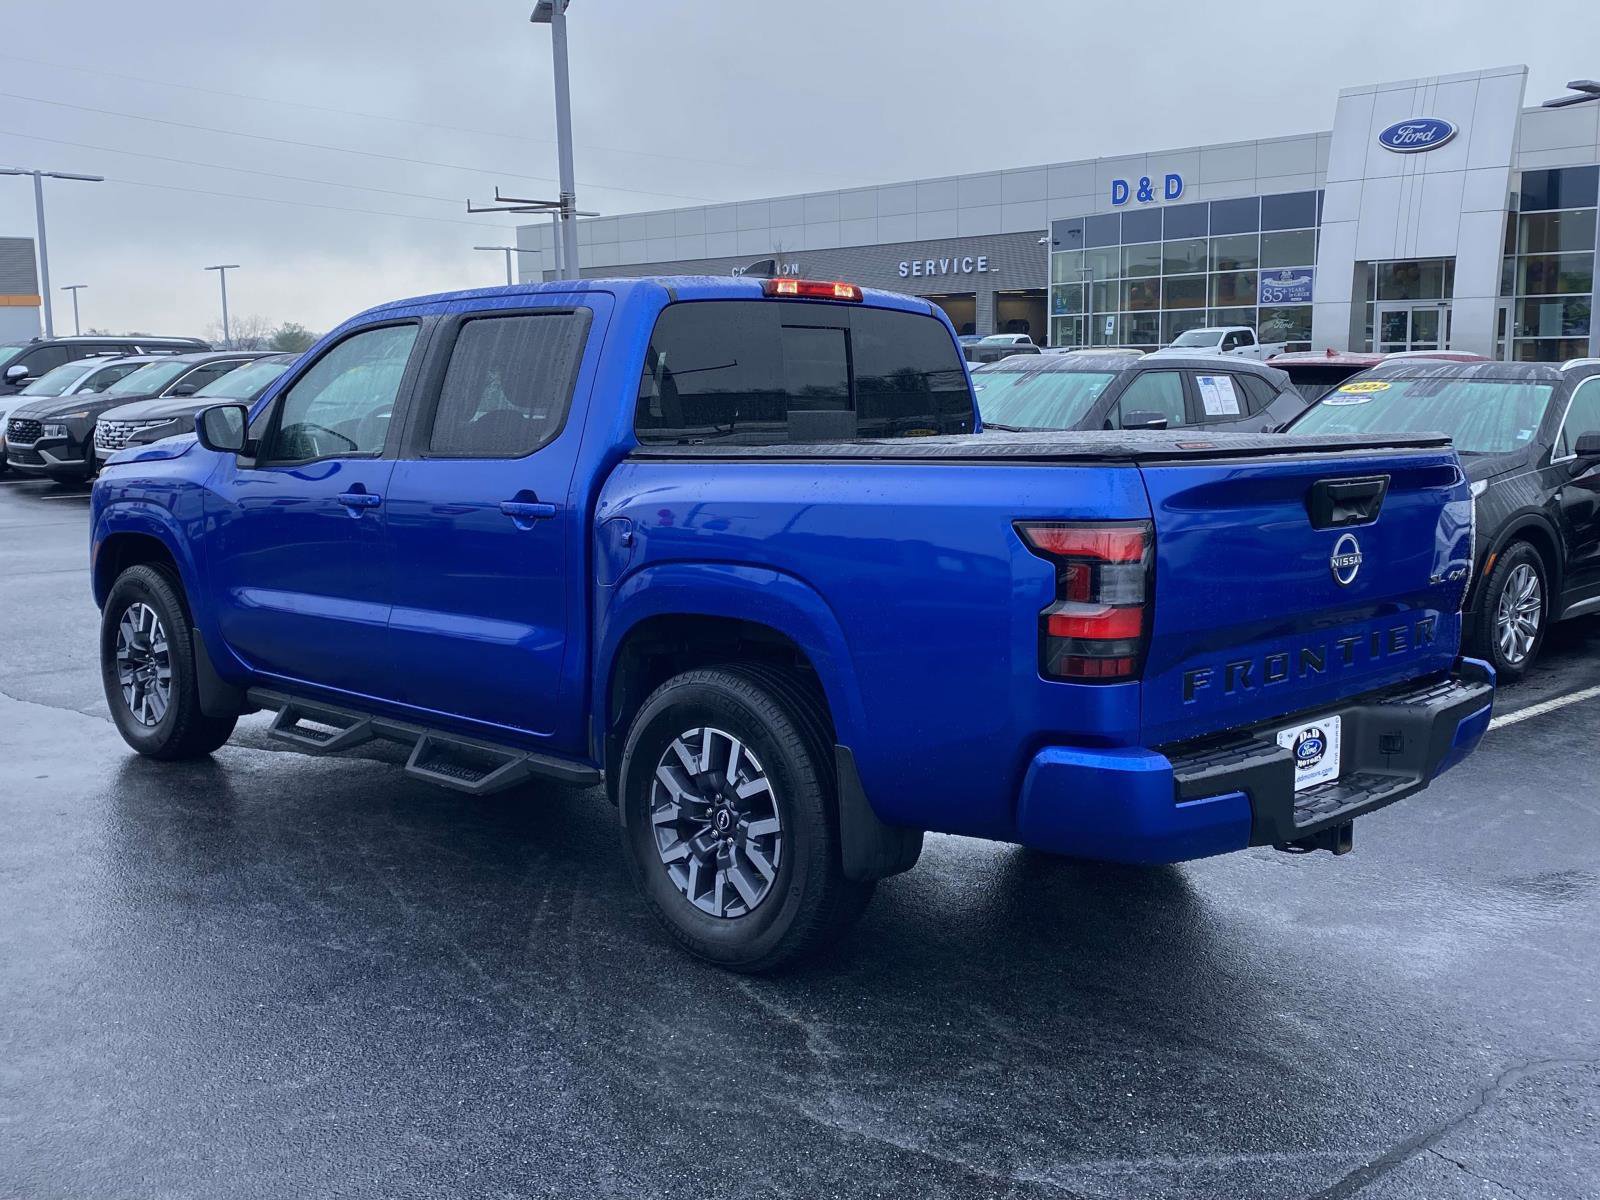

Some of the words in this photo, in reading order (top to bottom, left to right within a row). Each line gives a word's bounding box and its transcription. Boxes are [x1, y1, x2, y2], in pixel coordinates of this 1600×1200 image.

[1392, 123, 1437, 144] Ford
[1111, 179, 1129, 205] D
[1136, 176, 1154, 202] &
[1164, 173, 1184, 200] D
[898, 256, 988, 278] SERVICE
[1183, 618, 1436, 705] FRONTIER
[1297, 754, 1322, 768] MOTORS
